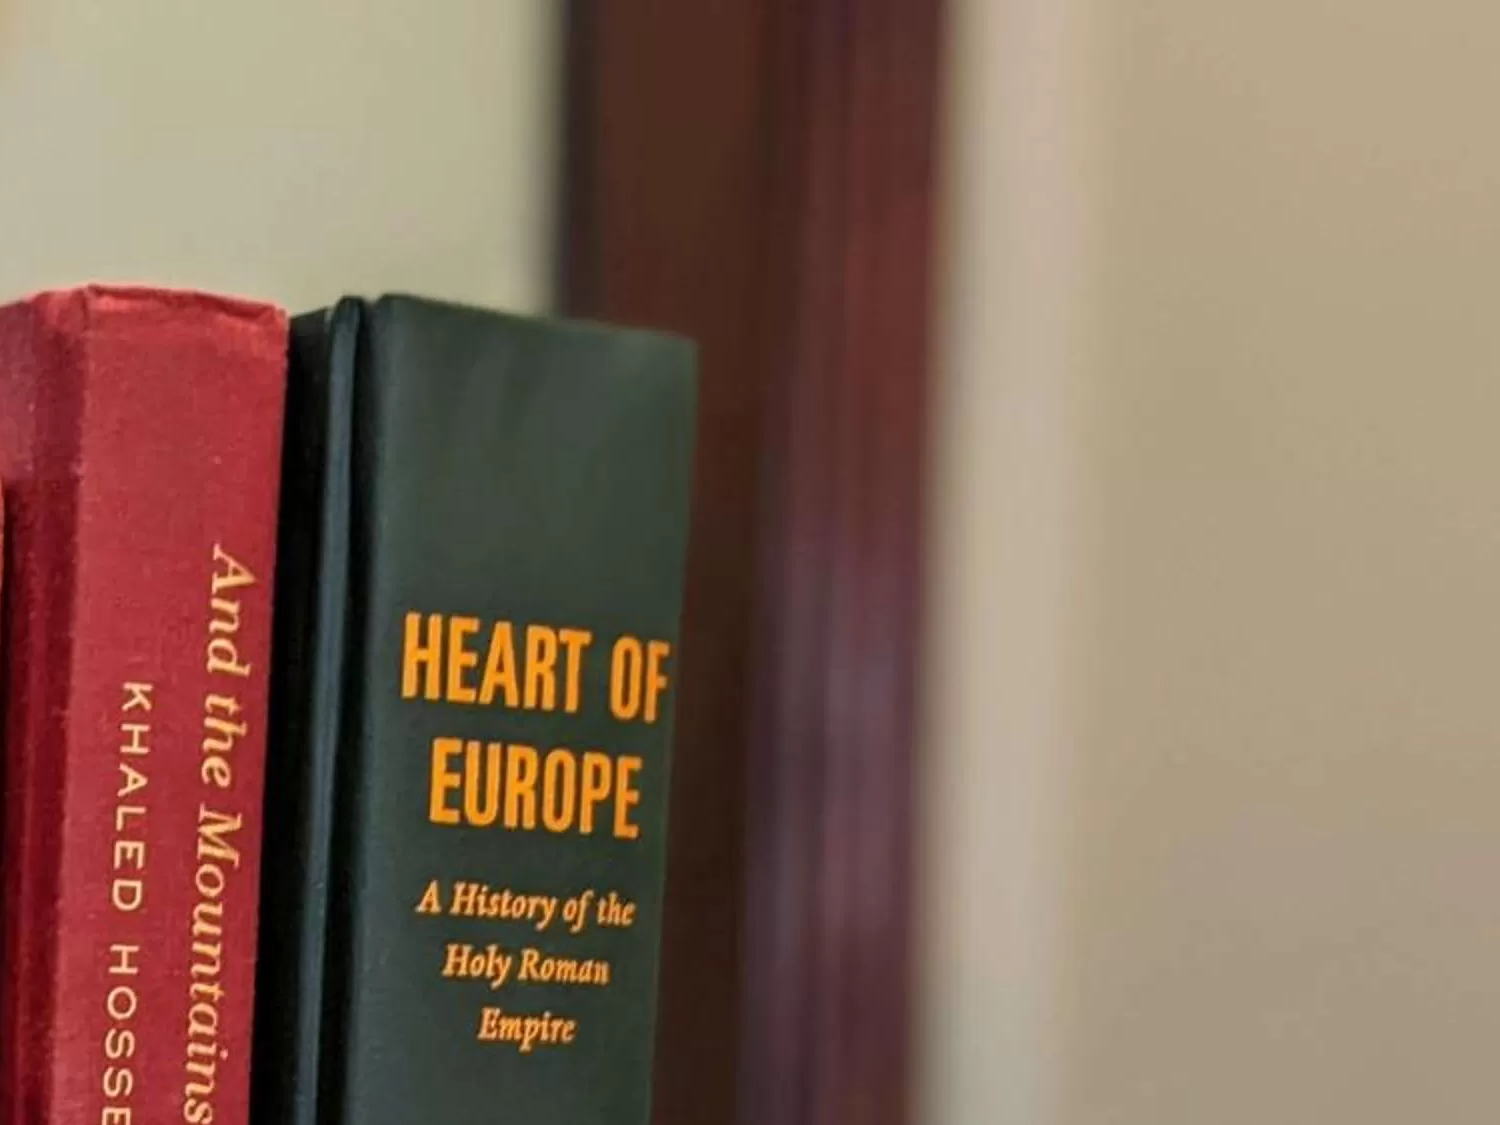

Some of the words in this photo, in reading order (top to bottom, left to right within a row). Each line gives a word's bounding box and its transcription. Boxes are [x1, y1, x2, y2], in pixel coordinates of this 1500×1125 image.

[204, 543, 258, 676] And
[401, 611, 591, 713] HEART
[608, 635, 671, 724] OF
[201, 693, 249, 789] the
[428, 737, 642, 839] EUROPE
[111, 680, 154, 913] KHALED
[416, 880, 442, 915] A
[450, 883, 556, 930] History
[561, 888, 594, 934] of
[596, 891, 636, 928] the
[441, 944, 510, 989] Holy
[517, 948, 610, 986] Roman
[476, 1008, 576, 1053] Empire
